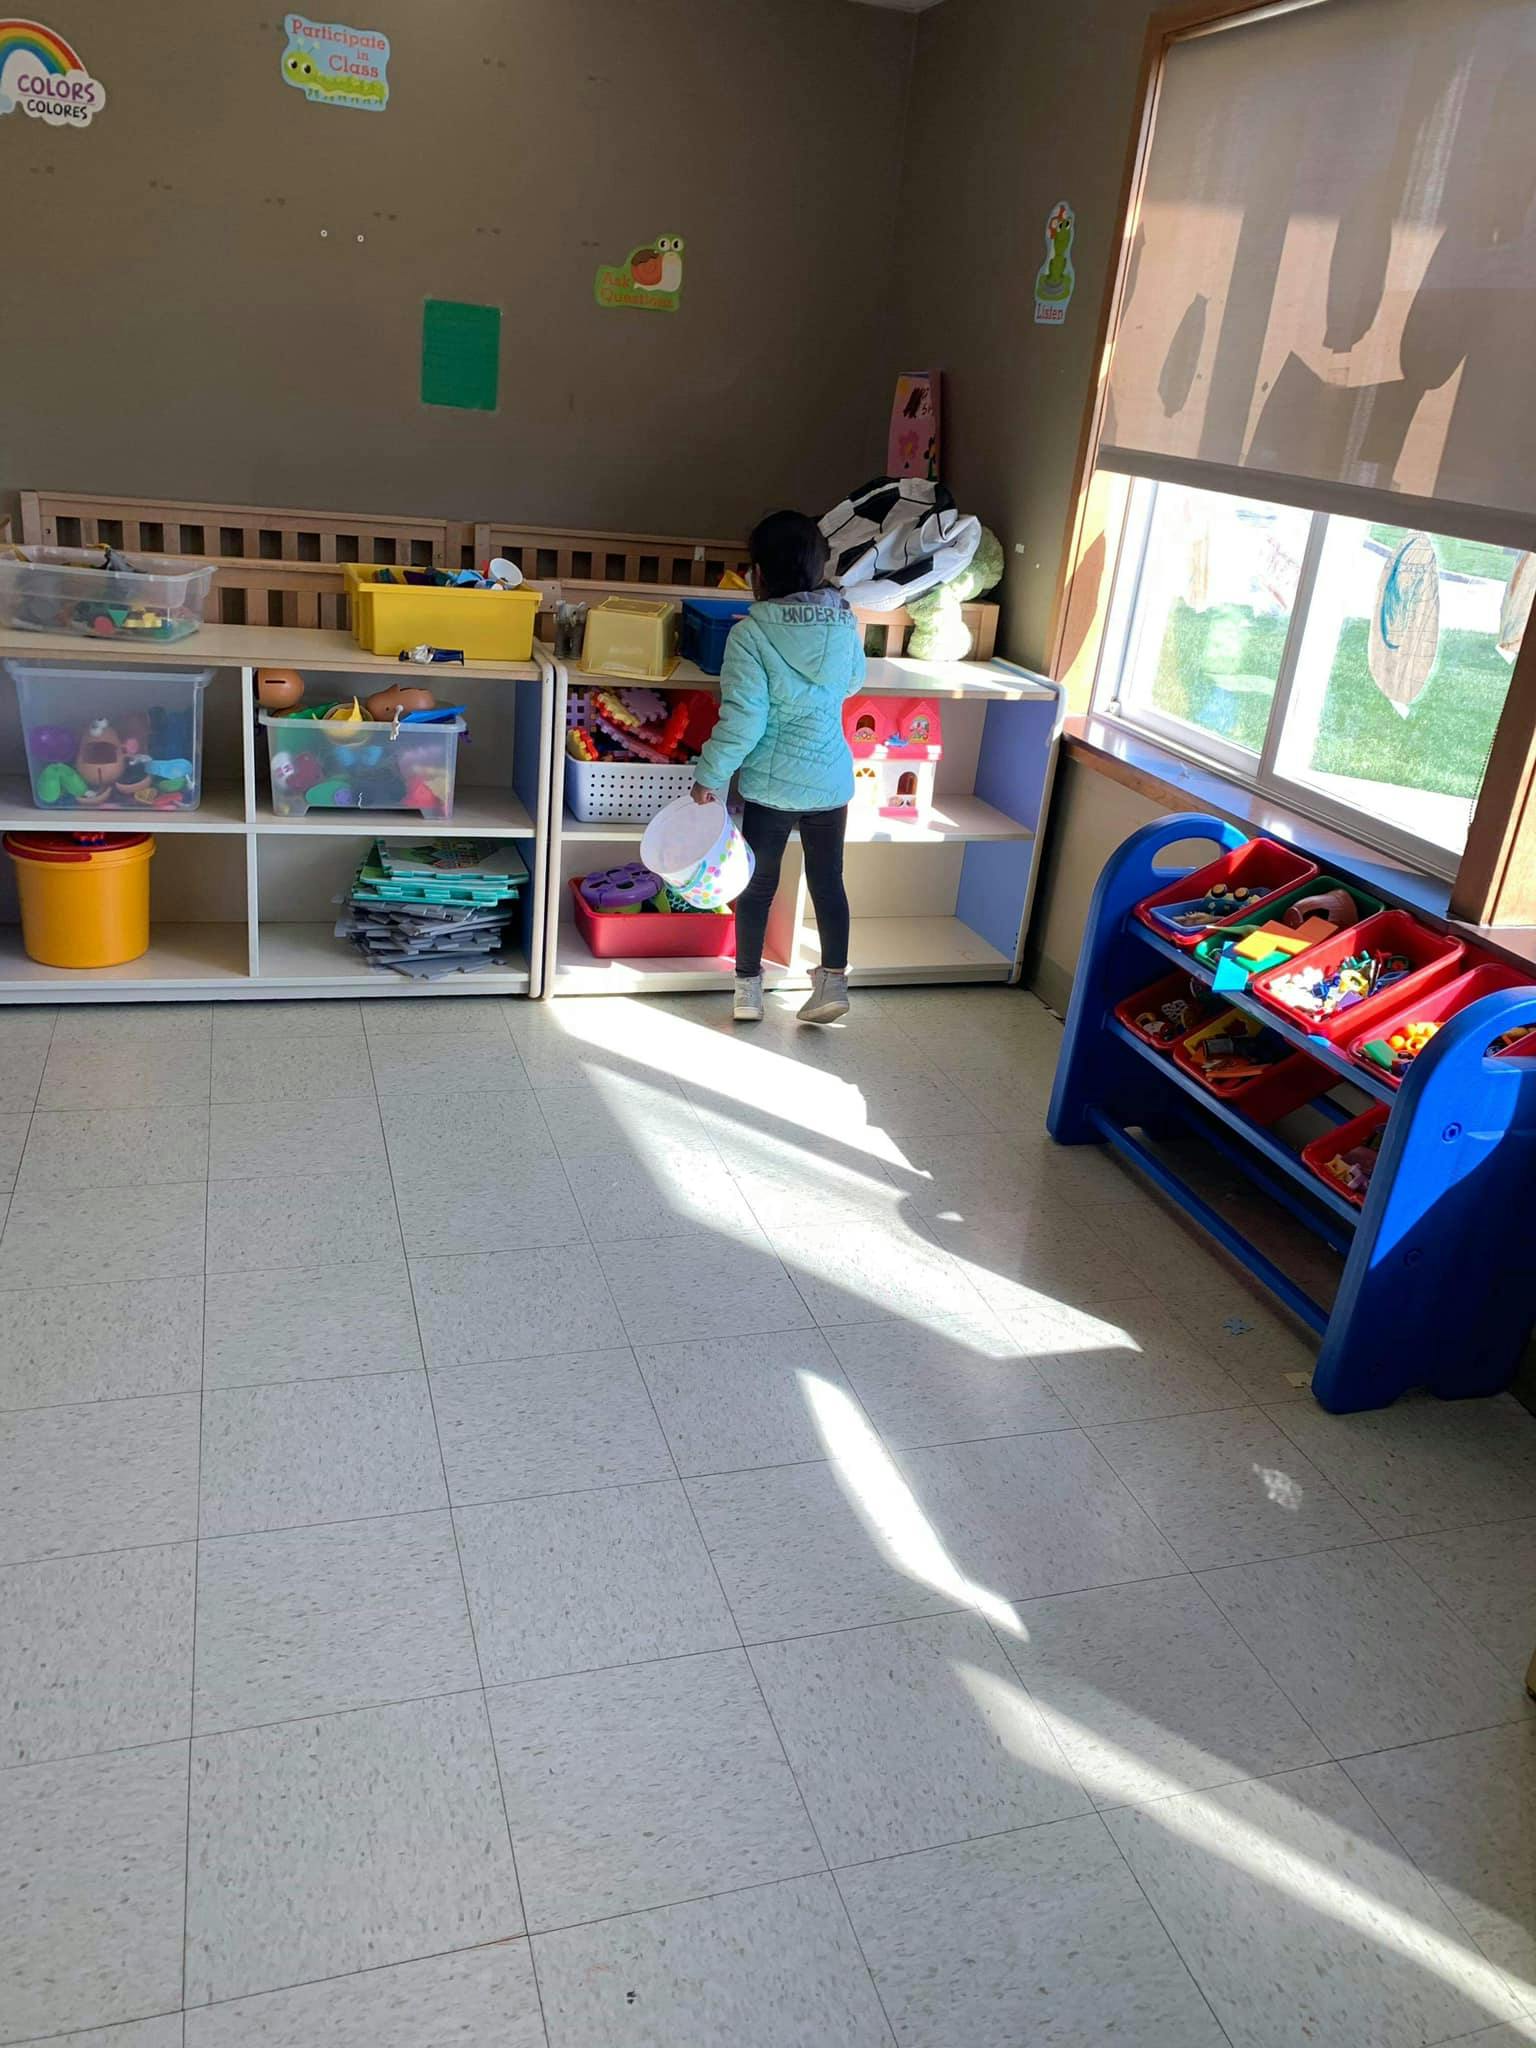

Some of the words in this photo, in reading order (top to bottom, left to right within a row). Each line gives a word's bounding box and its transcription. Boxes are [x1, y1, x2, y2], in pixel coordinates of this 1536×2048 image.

[292, 18, 385, 50] Participate
[357, 48, 369, 61] in
[328, 54, 379, 77] Class
[17, 74, 95, 103] COLORS
[27, 99, 88, 120] COLORES
[602, 271, 629, 288] Ask
[599, 287, 673, 308] Questions
[783, 606, 836, 624] UNDER
